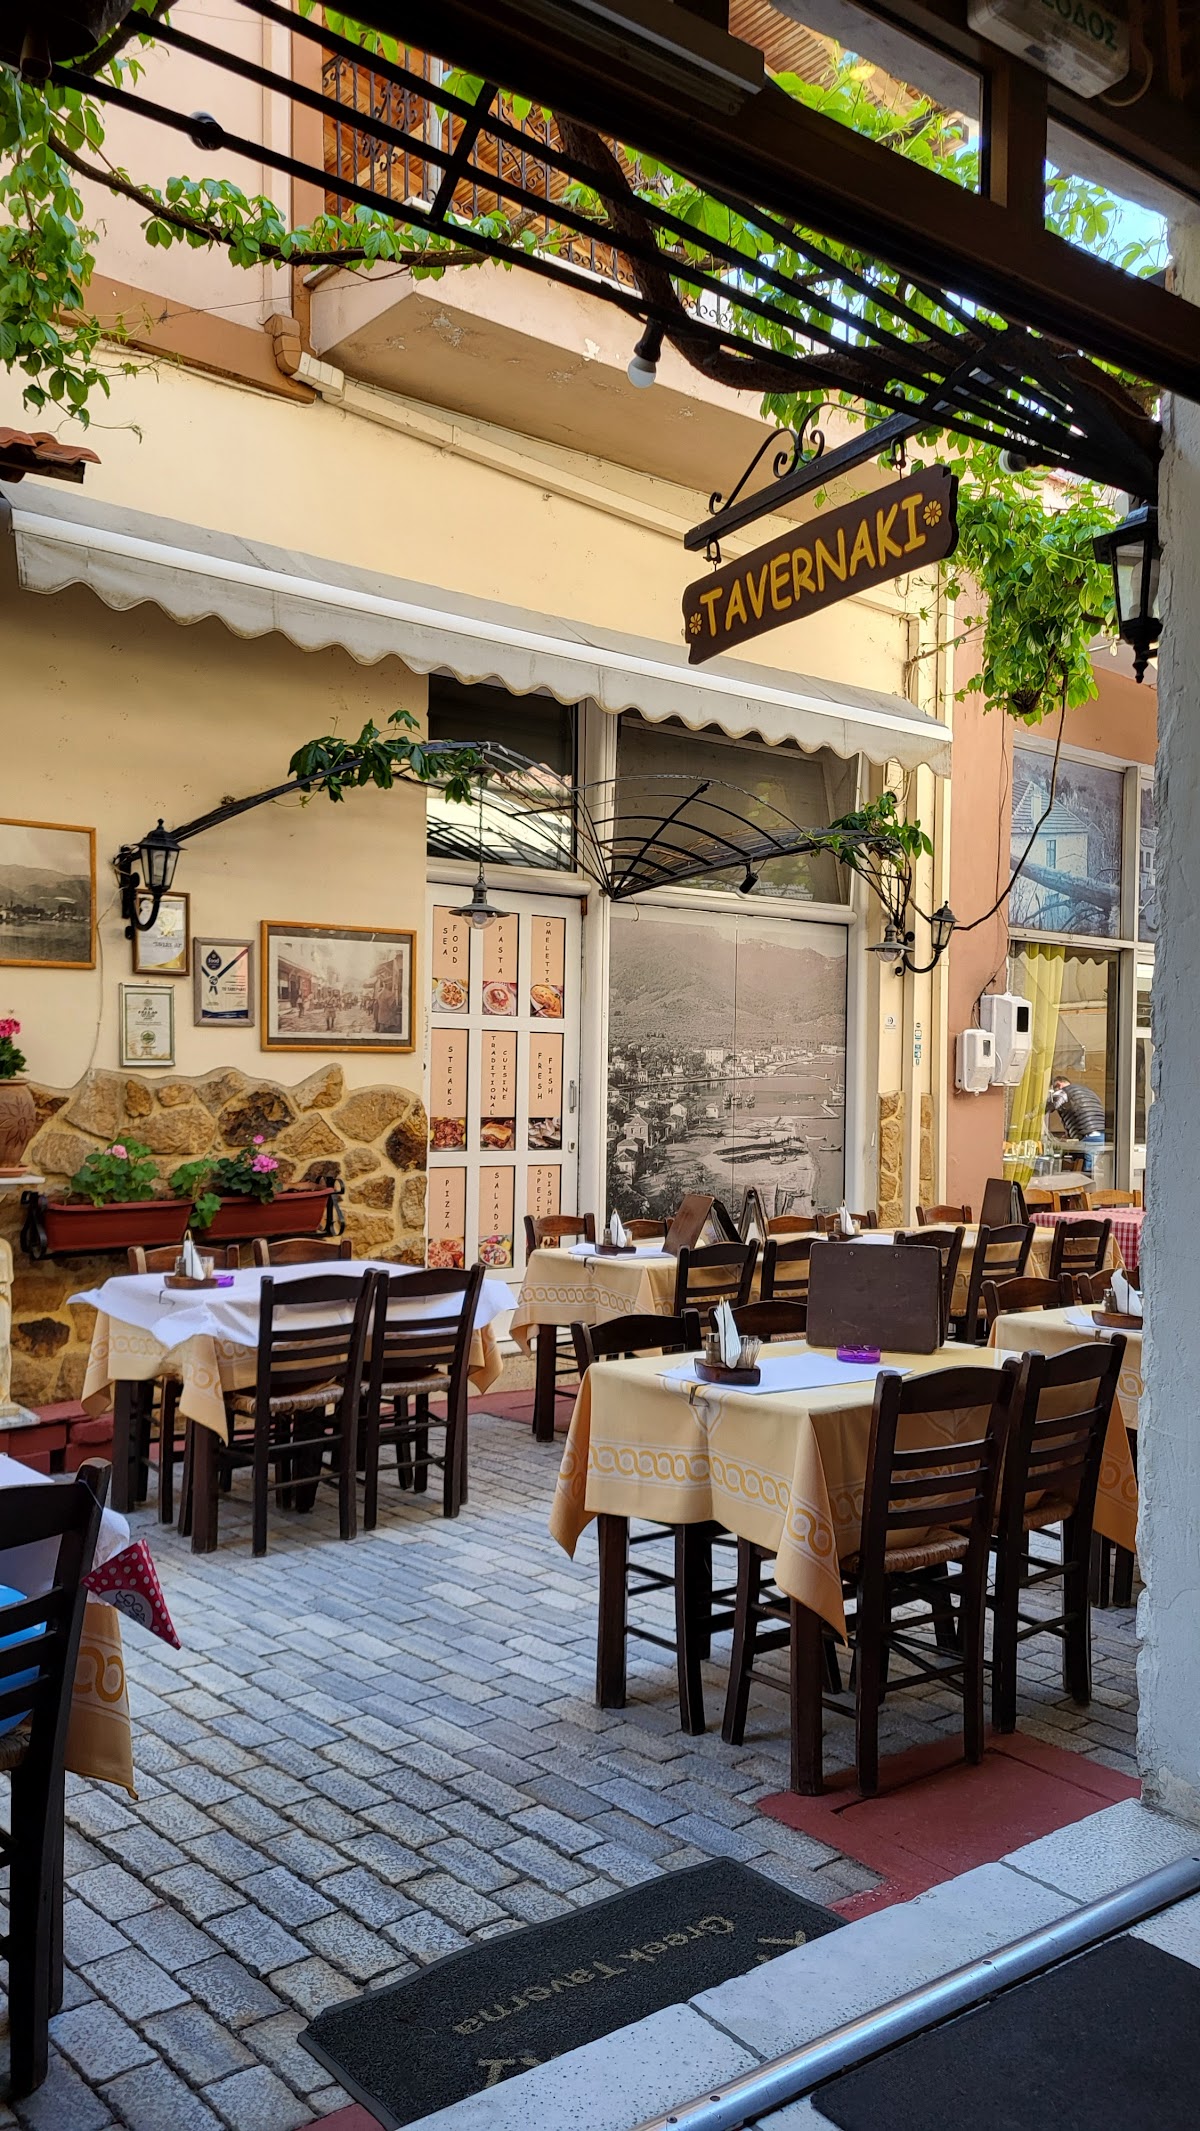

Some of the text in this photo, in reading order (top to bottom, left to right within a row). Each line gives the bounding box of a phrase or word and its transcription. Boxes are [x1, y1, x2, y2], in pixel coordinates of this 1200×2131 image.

[1041, 0, 1118, 51] ΟΔΟΣ
[699, 493, 927, 637] TAVERNAKI
[544, 921, 552, 983] OMELETTS
[615, 1915, 736, 1963] Greek
[453, 1960, 628, 2035] Taverna
